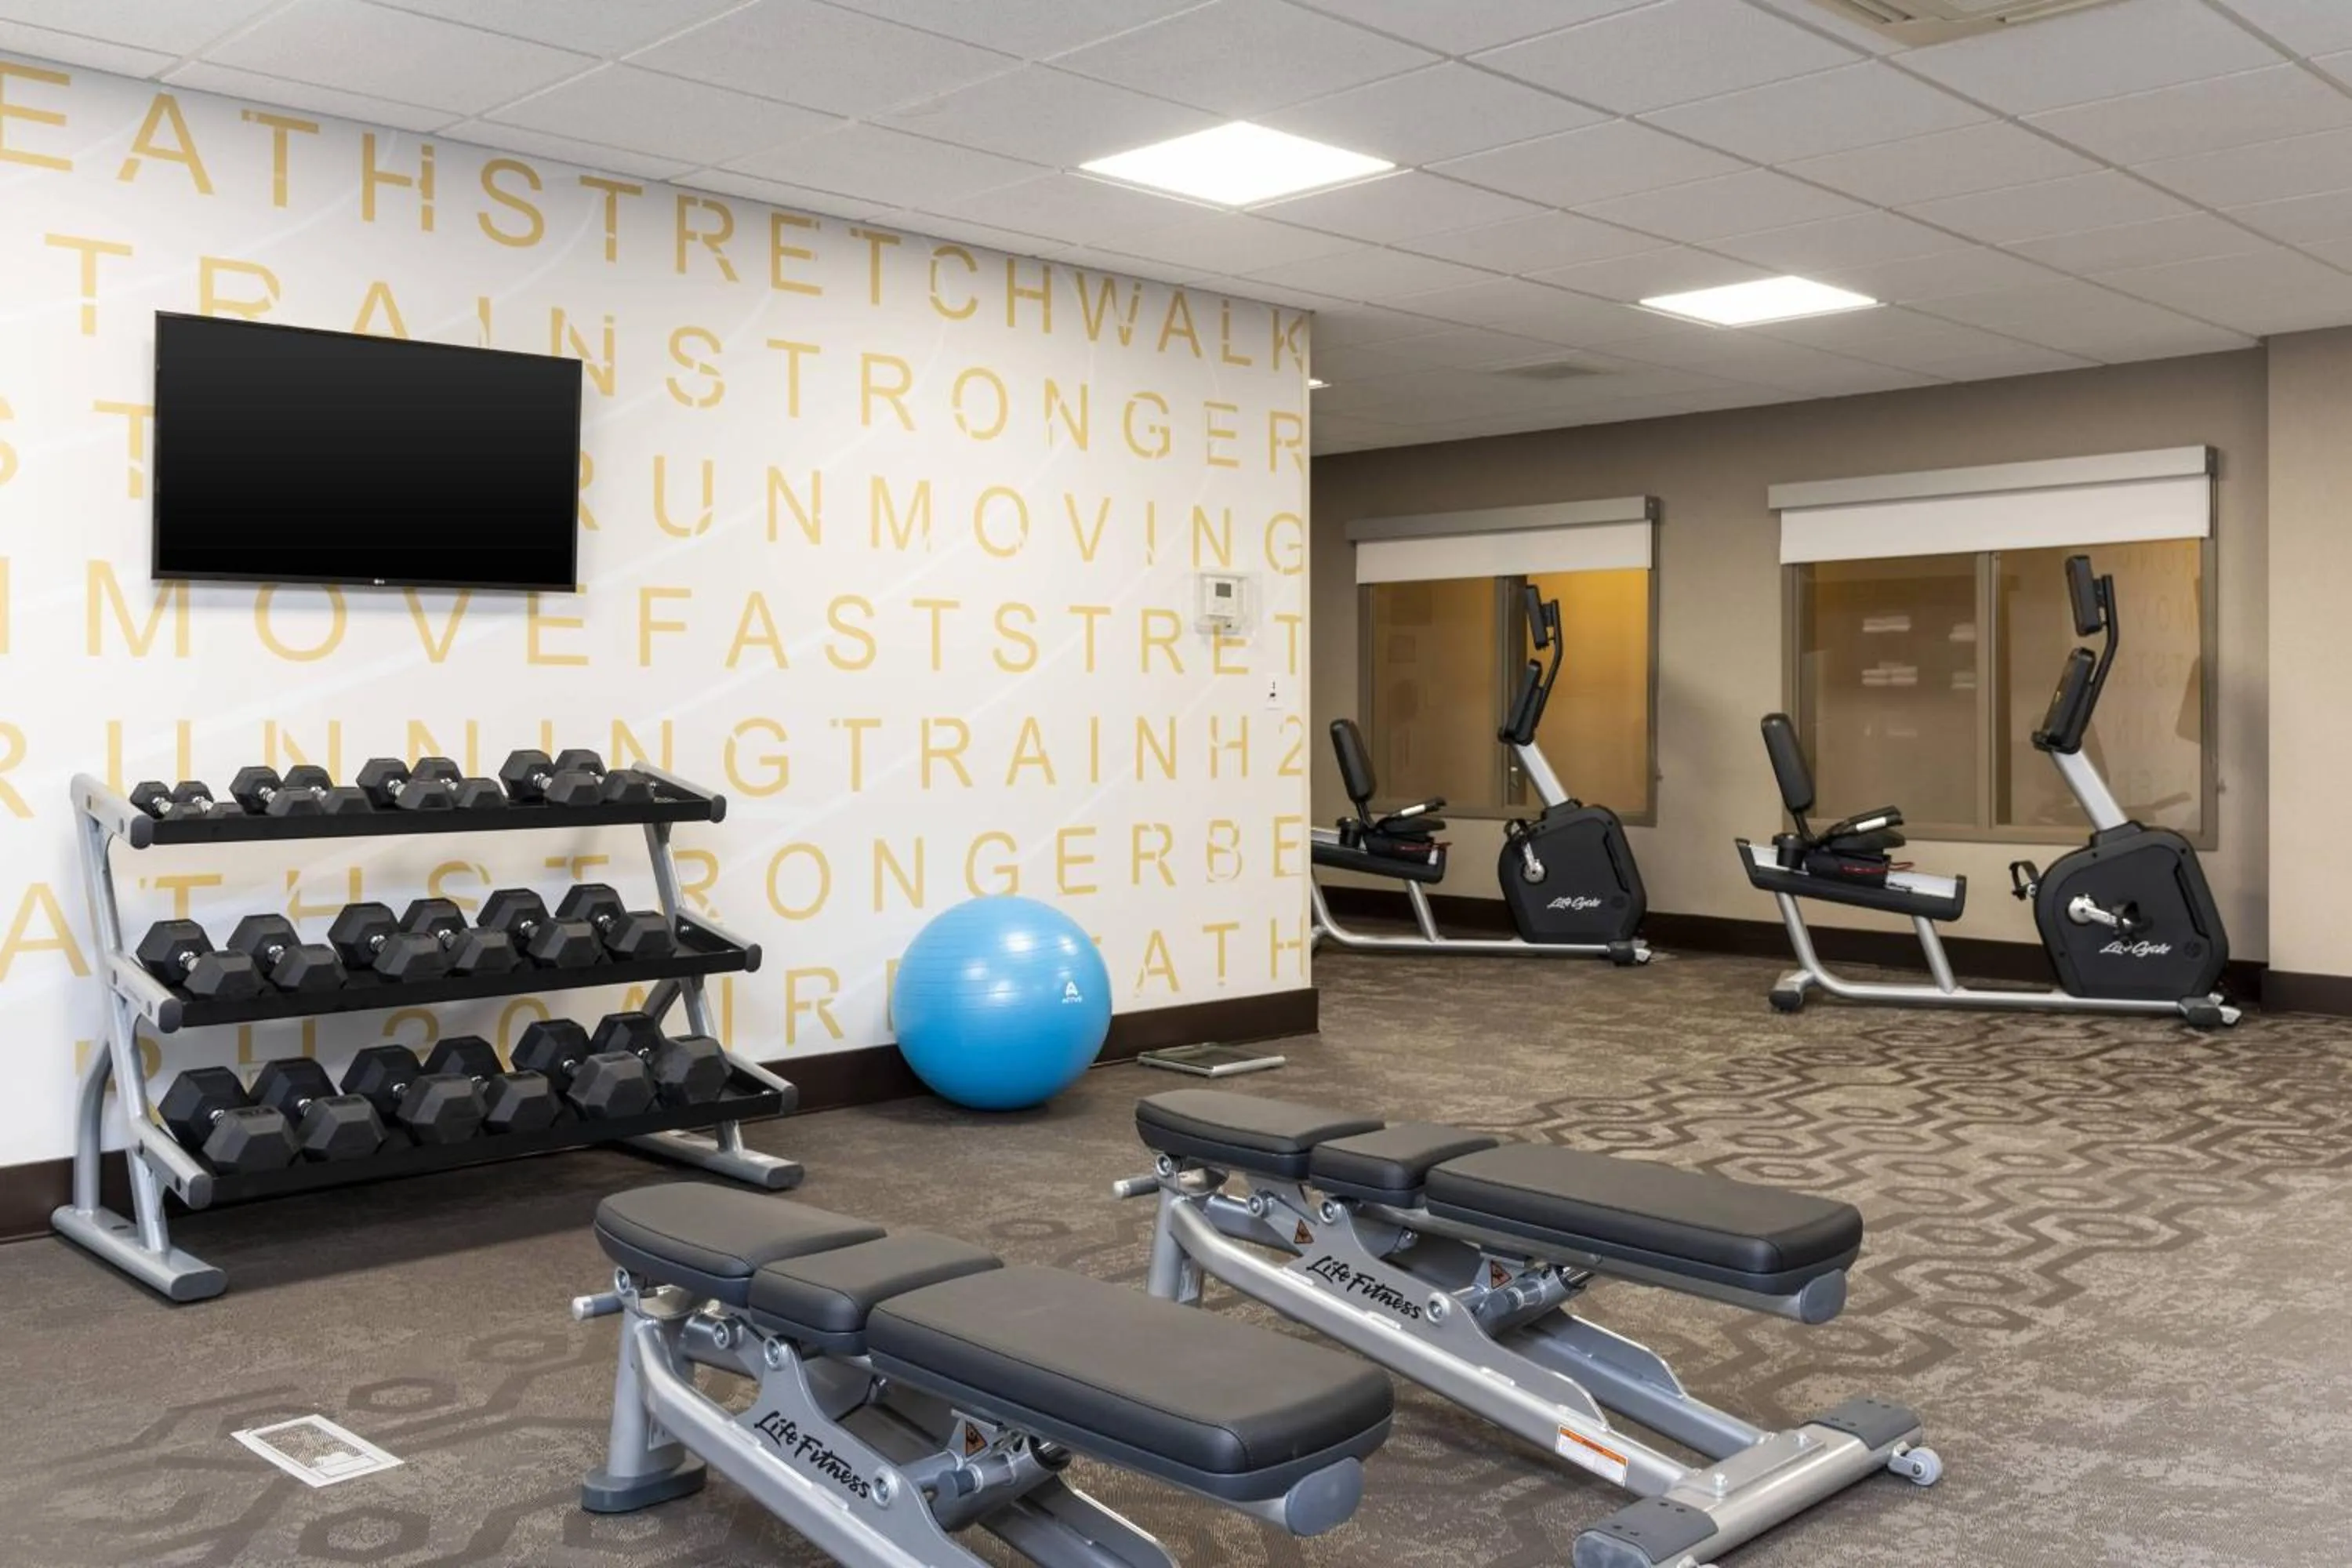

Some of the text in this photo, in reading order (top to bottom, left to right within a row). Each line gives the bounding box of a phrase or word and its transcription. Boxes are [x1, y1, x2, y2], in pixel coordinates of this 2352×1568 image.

[1305, 1255, 1422, 1319] Life Fitness
[753, 1410, 871, 1499] Life Fitness
